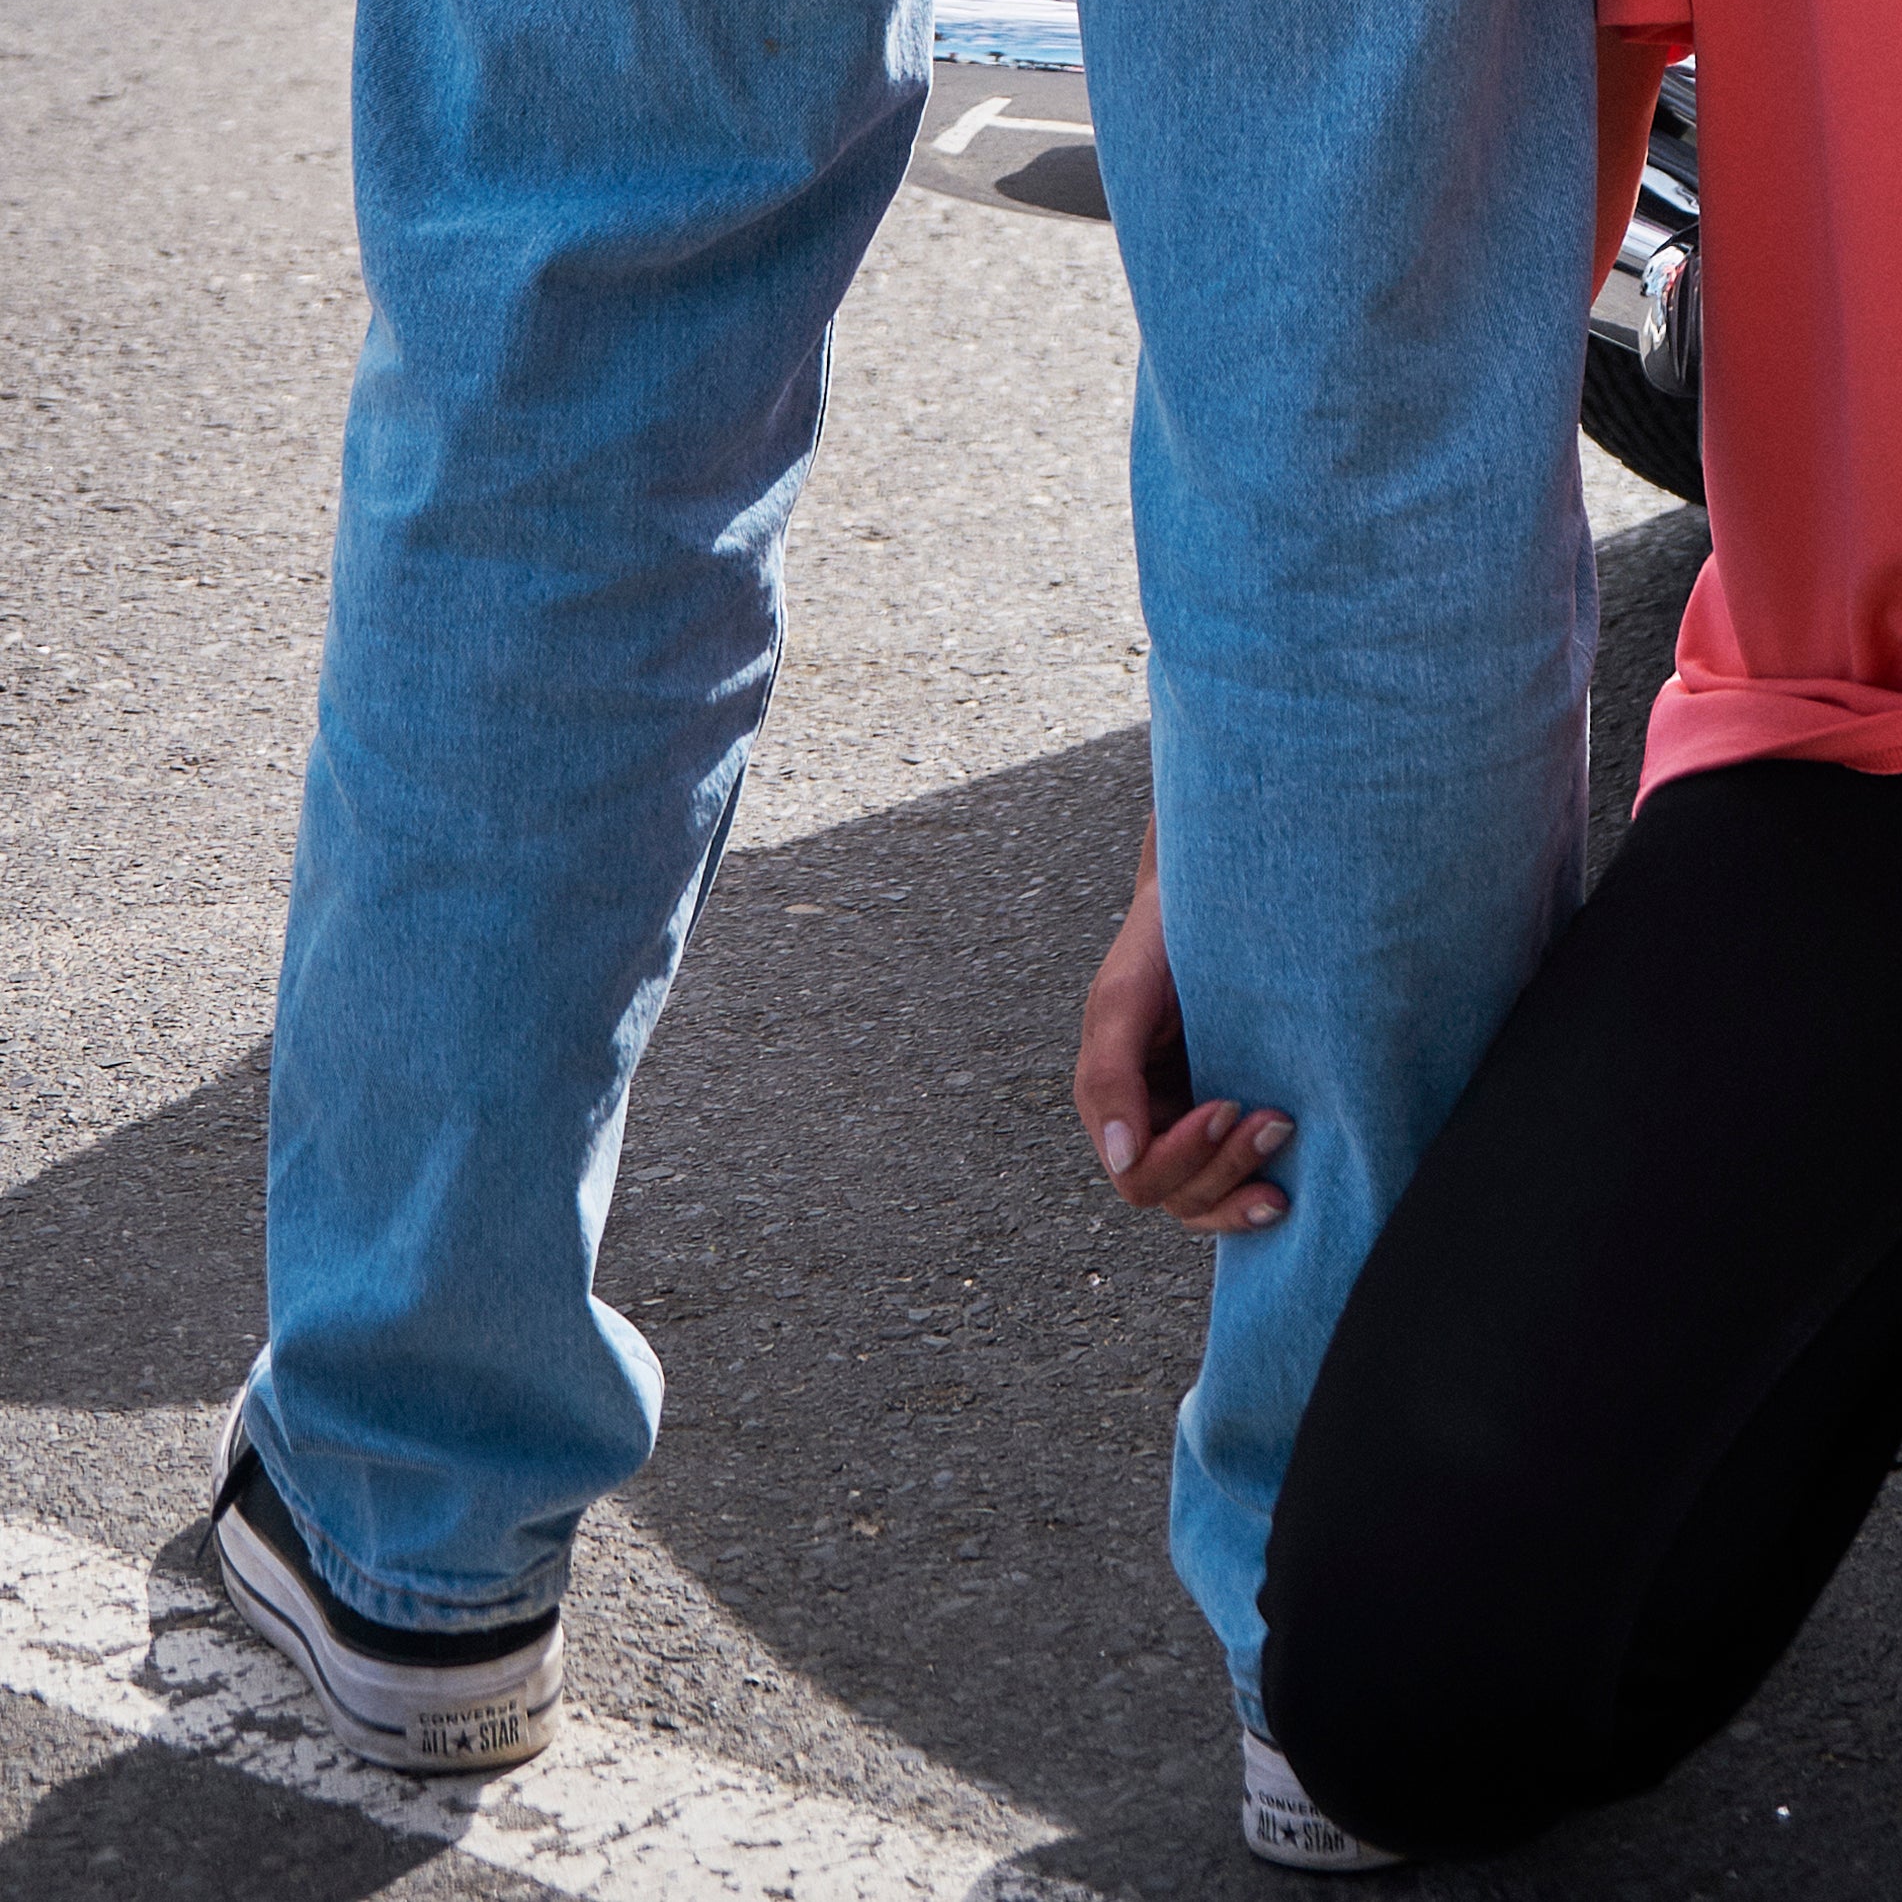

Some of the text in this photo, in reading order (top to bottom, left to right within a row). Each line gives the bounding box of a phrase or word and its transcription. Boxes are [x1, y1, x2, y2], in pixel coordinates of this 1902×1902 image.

[422, 1715, 519, 1756] ALL STAR
[1259, 1790, 1321, 1817] CONVER
[1257, 1807, 1345, 1854] ALL STAR
